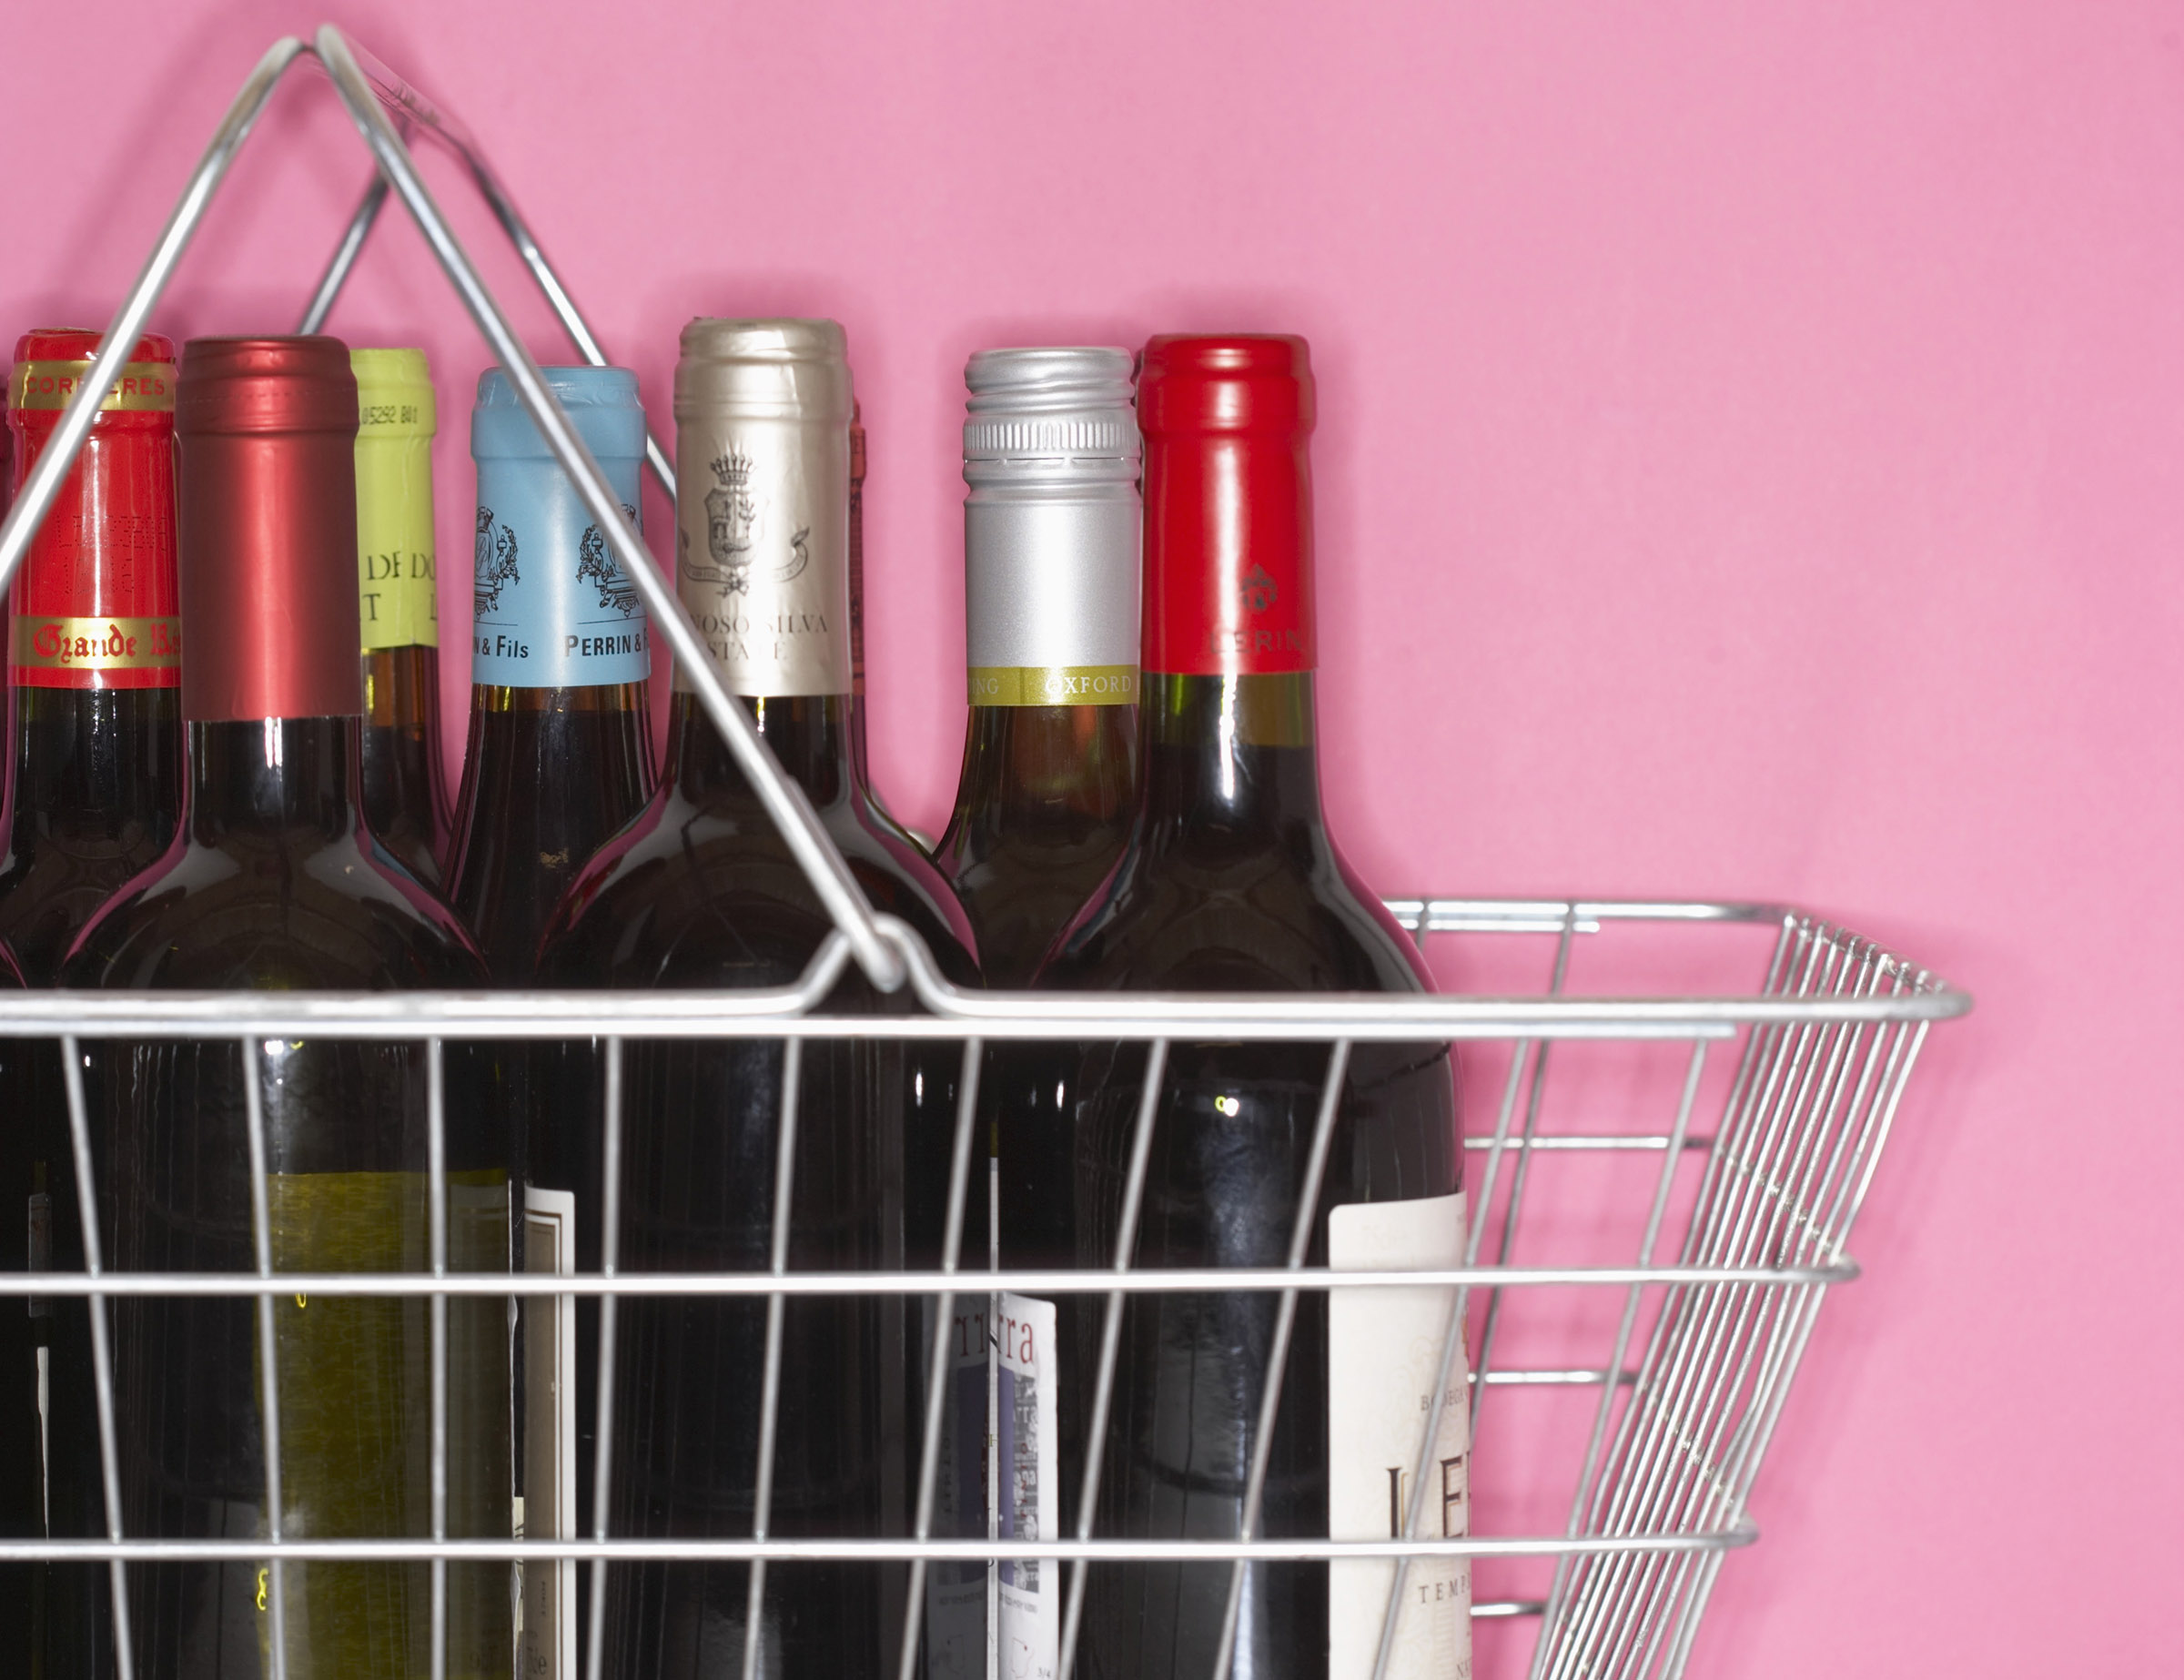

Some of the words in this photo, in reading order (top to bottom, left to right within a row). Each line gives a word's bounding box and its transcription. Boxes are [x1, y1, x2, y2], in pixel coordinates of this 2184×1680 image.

[33, 623, 137, 664] Grande
[497, 634, 530, 659] Fils
[564, 634, 632, 657] PERRIN
[1045, 674, 1131, 694] OXFORD
